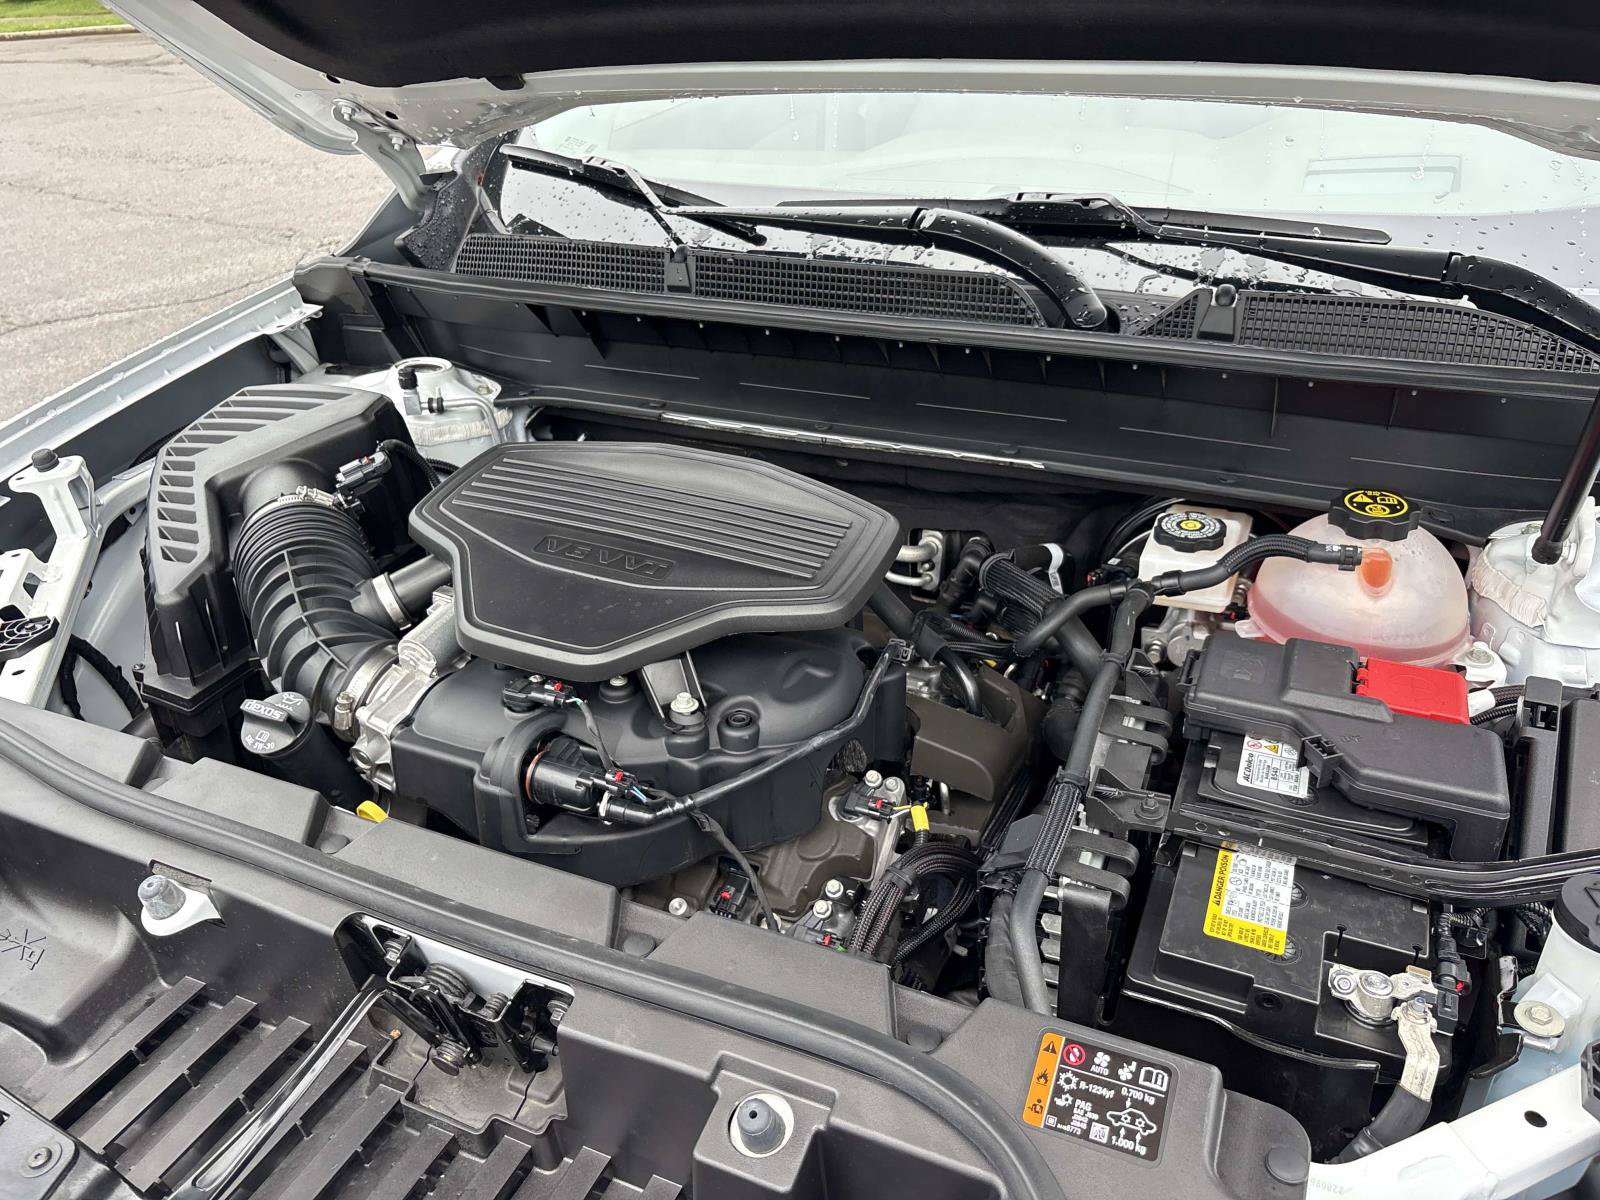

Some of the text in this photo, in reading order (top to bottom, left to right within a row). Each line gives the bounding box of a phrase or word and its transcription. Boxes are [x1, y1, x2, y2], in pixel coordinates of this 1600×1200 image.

[599, 549, 669, 575] VVT
[244, 700, 285, 720] dexos
[253, 741, 275, 751] 5W-30
[1242, 752, 1255, 783] ACDelco
[1220, 854, 1229, 875] POISON
[1090, 1065, 1109, 1076] AUTO
[1079, 1082, 1115, 1099] R-1234yf
[1121, 1086, 1156, 1106] 0.700 kg
[1074, 1099, 1092, 1111] PAG
[1111, 1135, 1134, 1150] 1.000
